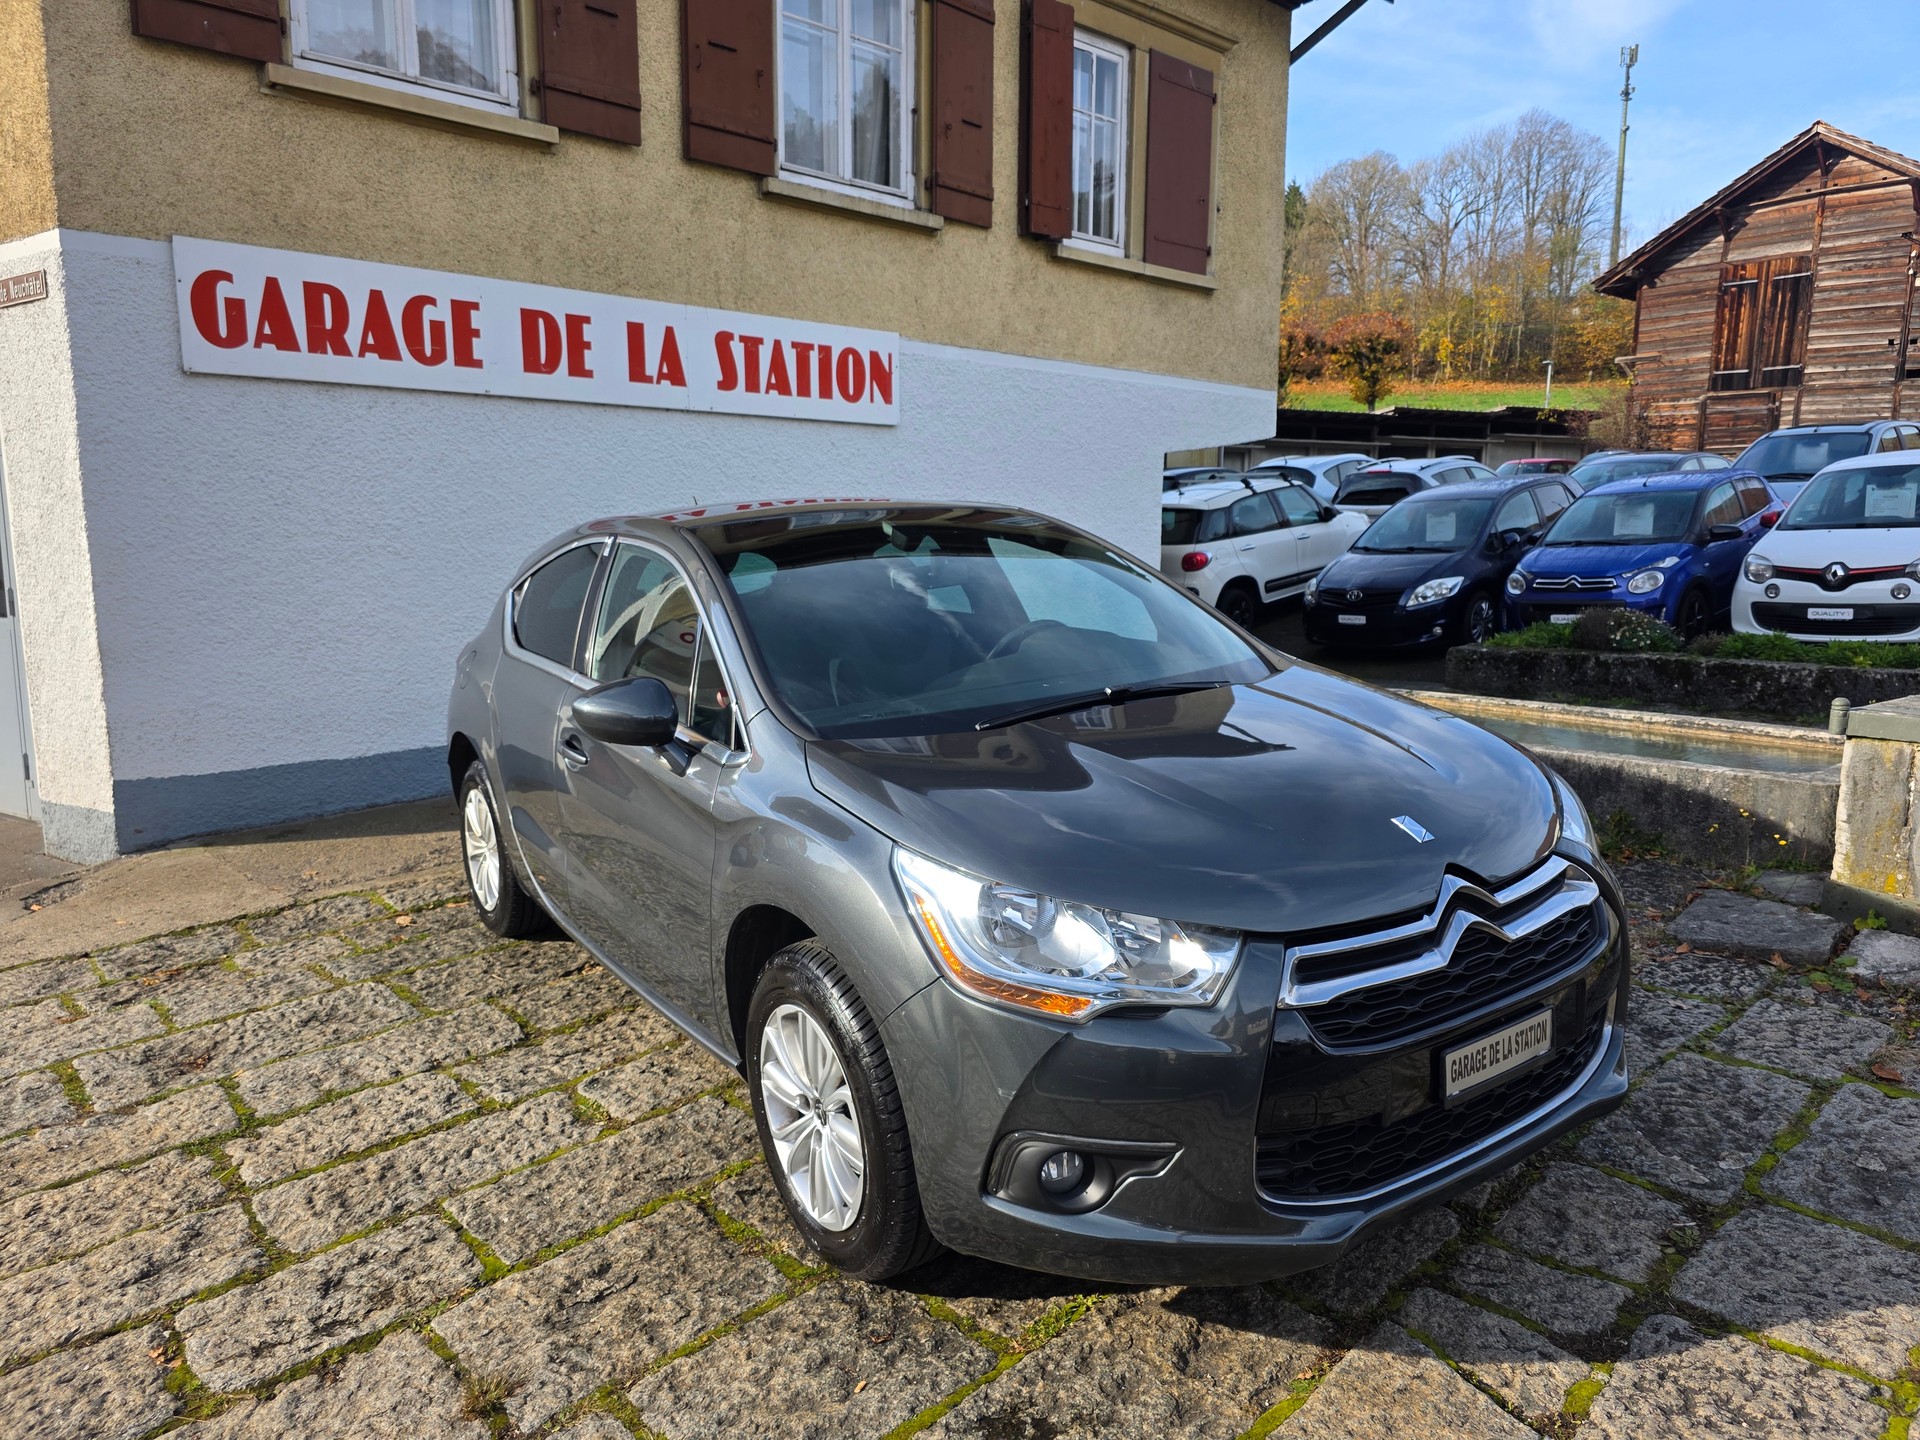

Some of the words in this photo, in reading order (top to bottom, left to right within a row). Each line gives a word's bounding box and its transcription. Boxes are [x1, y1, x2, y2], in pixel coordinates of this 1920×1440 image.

[9, 272, 43, 300] Neuchâtel
[190, 269, 484, 369] GARAGE
[520, 307, 595, 379] DE
[626, 320, 688, 388] LA
[714, 330, 894, 405] STATION
[1450, 1046, 1487, 1083] GARAGE
[1489, 1040, 1500, 1067] DE
[1502, 1035, 1513, 1061] LA
[1515, 1019, 1548, 1055] STATION
